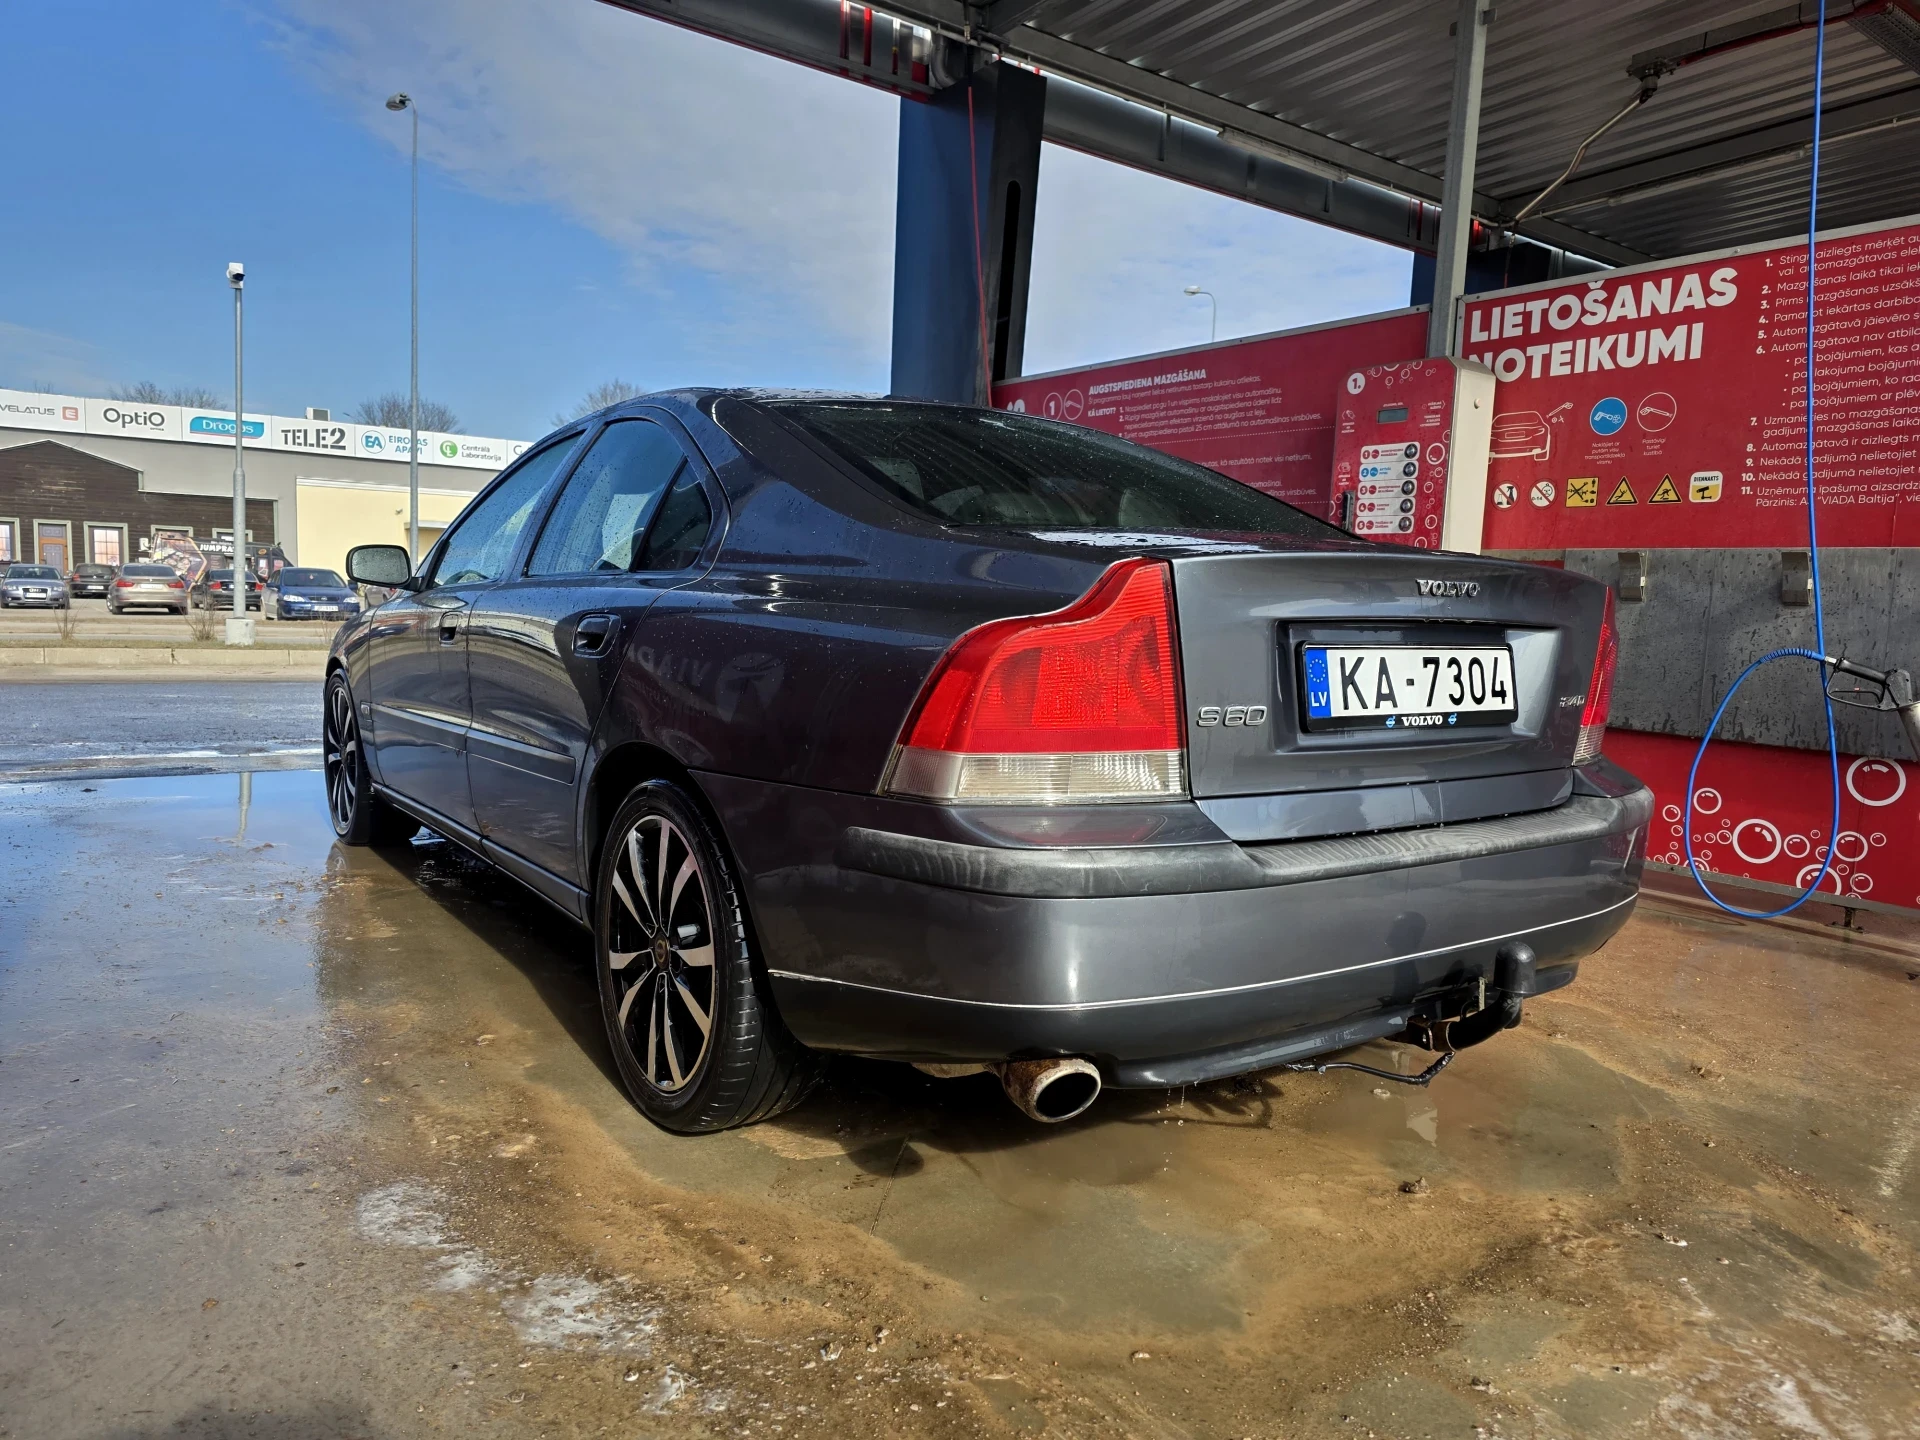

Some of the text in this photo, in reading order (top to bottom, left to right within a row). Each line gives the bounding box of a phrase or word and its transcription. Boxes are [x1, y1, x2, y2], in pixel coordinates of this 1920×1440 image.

[1816, 244, 1862, 260] aizliegts
[1865, 236, 1906, 251] mērķēt
[1778, 266, 1795, 277] vai
[1800, 251, 1898, 274] atomazgātavas
[1777, 274, 1847, 292] Mazgšanas
[1850, 269, 1876, 281] laikā
[1880, 264, 1904, 276] tikai
[1470, 267, 1739, 343] LIETOŠANAS
[1775, 296, 1804, 308] Pirms
[1826, 302, 1871, 316] iekārtas
[1772, 318, 1861, 338] Automzgātavā
[1863, 313, 1910, 329] jāievēro
[1770, 335, 1860, 353] Automzgātava
[1863, 333, 1885, 342] nav
[1794, 344, 1908, 367] pa bojājumiem, kas
[1793, 357, 1920, 381] pa lakojuma bojājumi
[1089, 368, 1207, 396] AUGSTSPIEDIENA MAZGĀŠANA
[1353, 377, 1361, 390] 1.
[1792, 385, 1810, 396] pa
[1813, 378, 1882, 392] bojājumiem,
[1885, 375, 1899, 385] ko
[1812, 393, 1878, 407] bojājumiem
[1880, 392, 1893, 401] ar
[103, 408, 165, 429] OptiO
[202, 419, 254, 434] Drogs
[1764, 413, 1829, 425] Uzmanieies
[1832, 412, 1846, 420] no
[1763, 426, 1813, 439] gadījum
[1816, 421, 1890, 434] mazgāšanas
[281, 427, 347, 451] TELE2
[388, 435, 428, 447] EIROAS
[1851, 436, 1859, 446] ir
[1861, 434, 1909, 446] aizliegts
[1760, 455, 1802, 466] Nekādā
[1860, 449, 1917, 461] nelietojiet
[1741, 472, 1755, 482] 10.
[1758, 471, 1800, 481] Nekādā
[1858, 465, 1915, 477] nelietojiet
[1741, 486, 1753, 495] 11.
[1819, 484, 1868, 496] īpašuma
[1755, 498, 1798, 508] Pārzinis:
[200, 543, 235, 553] JUMPRA
[1415, 579, 1481, 597] VOLVO
[1339, 656, 1508, 711] KA-7304
[1311, 691, 1328, 707] LV
[1401, 714, 1444, 727] VOLVO
